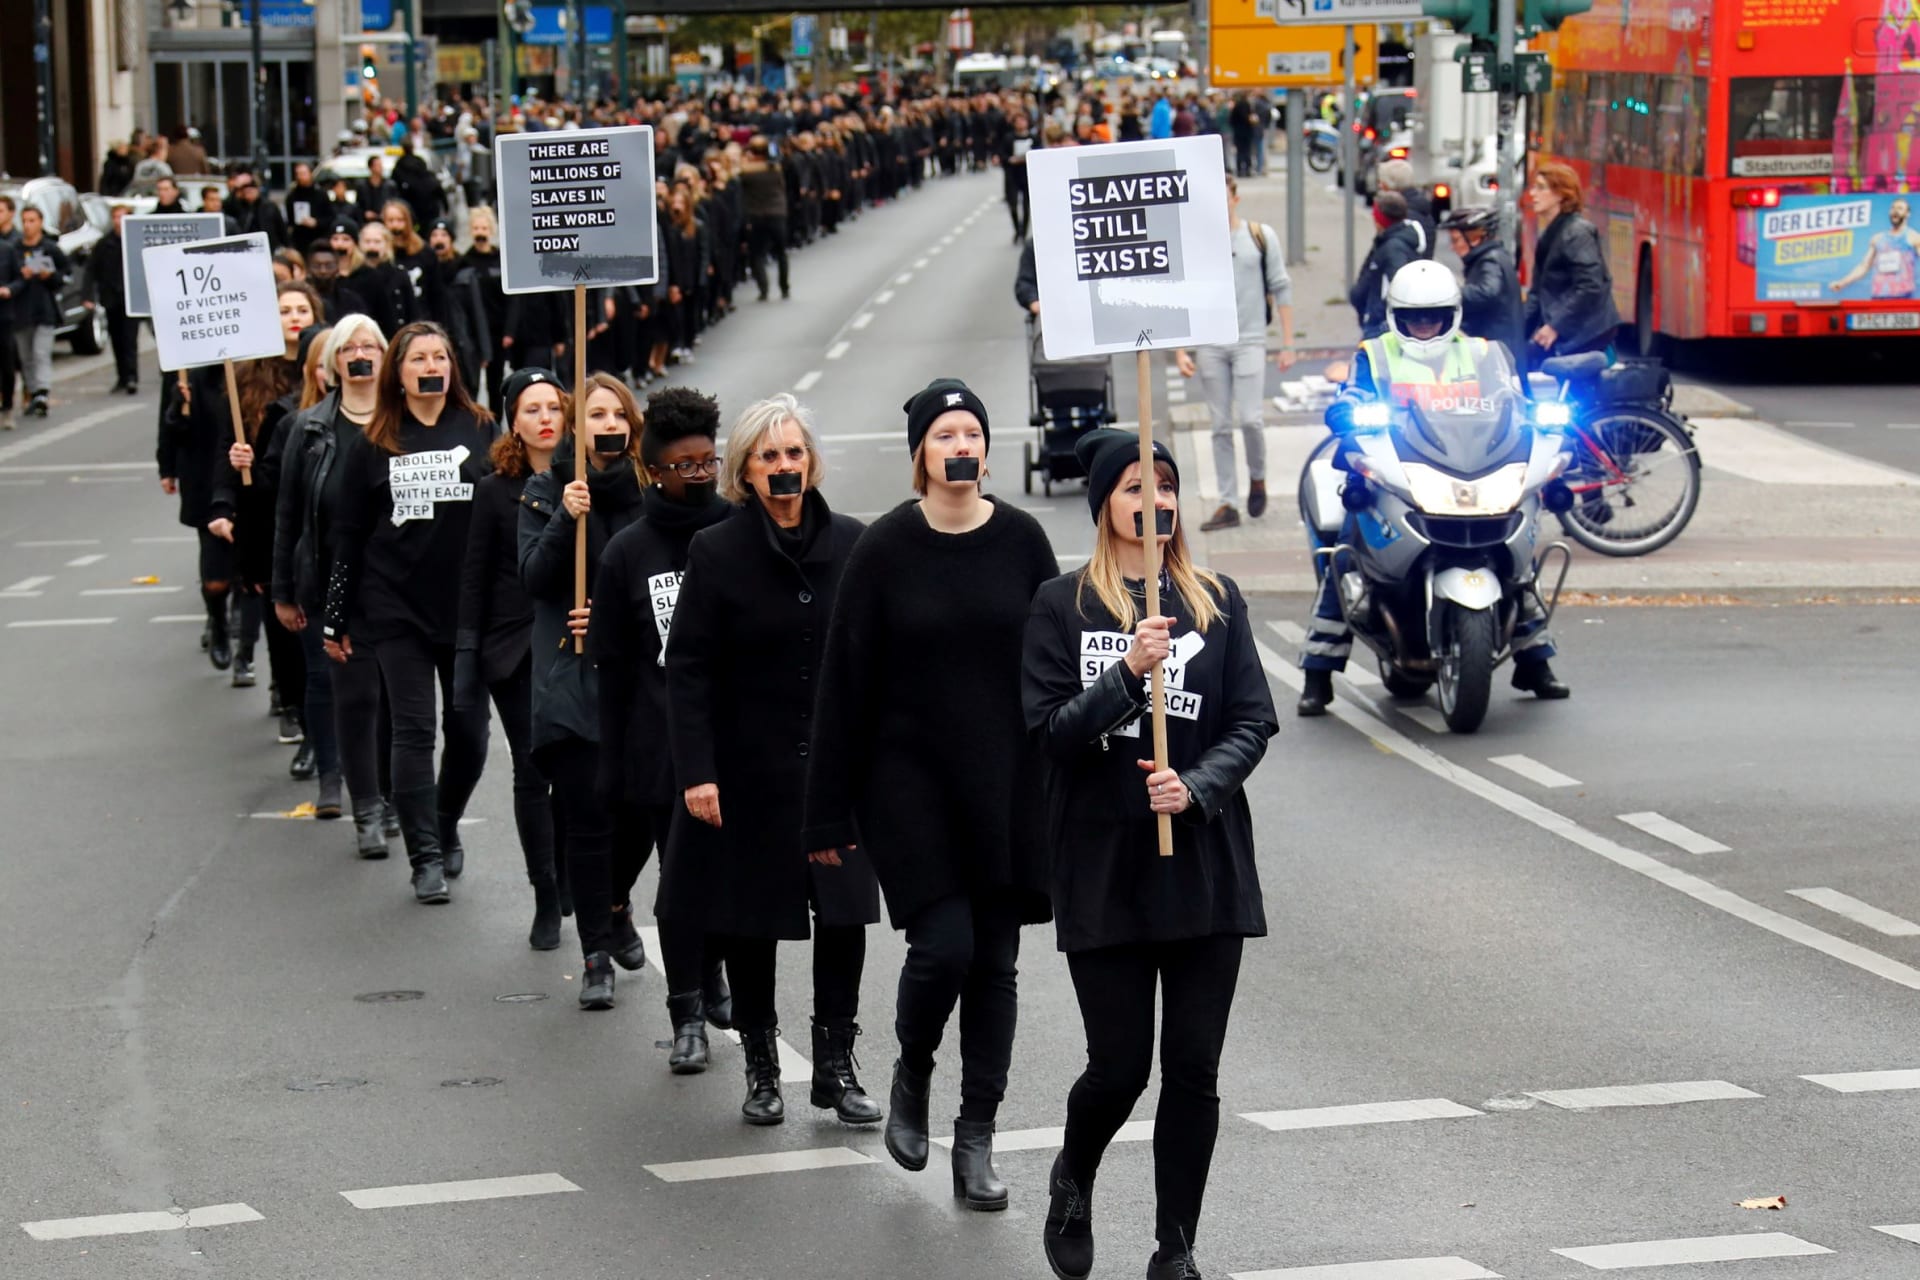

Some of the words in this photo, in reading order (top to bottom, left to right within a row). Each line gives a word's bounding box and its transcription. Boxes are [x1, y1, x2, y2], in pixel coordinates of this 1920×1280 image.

[529, 144, 576, 158] THERE
[581, 142, 609, 155] ARE
[530, 166, 598, 181] MILLIONS
[603, 164, 621, 177] OF
[532, 190, 586, 204] SLAVES
[591, 189, 605, 201] IN
[1070, 174, 1188, 206] SLAVERY
[533, 214, 560, 228] THE
[564, 212, 615, 226] WORLD
[1073, 213, 1147, 240] STILL
[1769, 214, 1801, 234] DER
[1806, 205, 1867, 228] LETZTE
[143, 223, 199, 234] ABOLISH
[534, 237, 579, 250] TODAY
[1780, 235, 1849, 261] SCHREI!
[1076, 246, 1169, 275] EXISTS
[176, 264, 221, 295] 1%
[177, 300, 192, 311] OF
[196, 292, 248, 307] VICTIMS
[179, 313, 205, 326] ARE
[209, 308, 241, 322] EVER
[181, 324, 240, 341] RESCUED
[1432, 397, 1495, 412] POLIZEI
[393, 453, 452, 468] ABOLISH
[393, 470, 455, 483] SLAVERY
[394, 488, 430, 499] WITH
[435, 486, 470, 498] EACH
[397, 505, 429, 516] STEP
